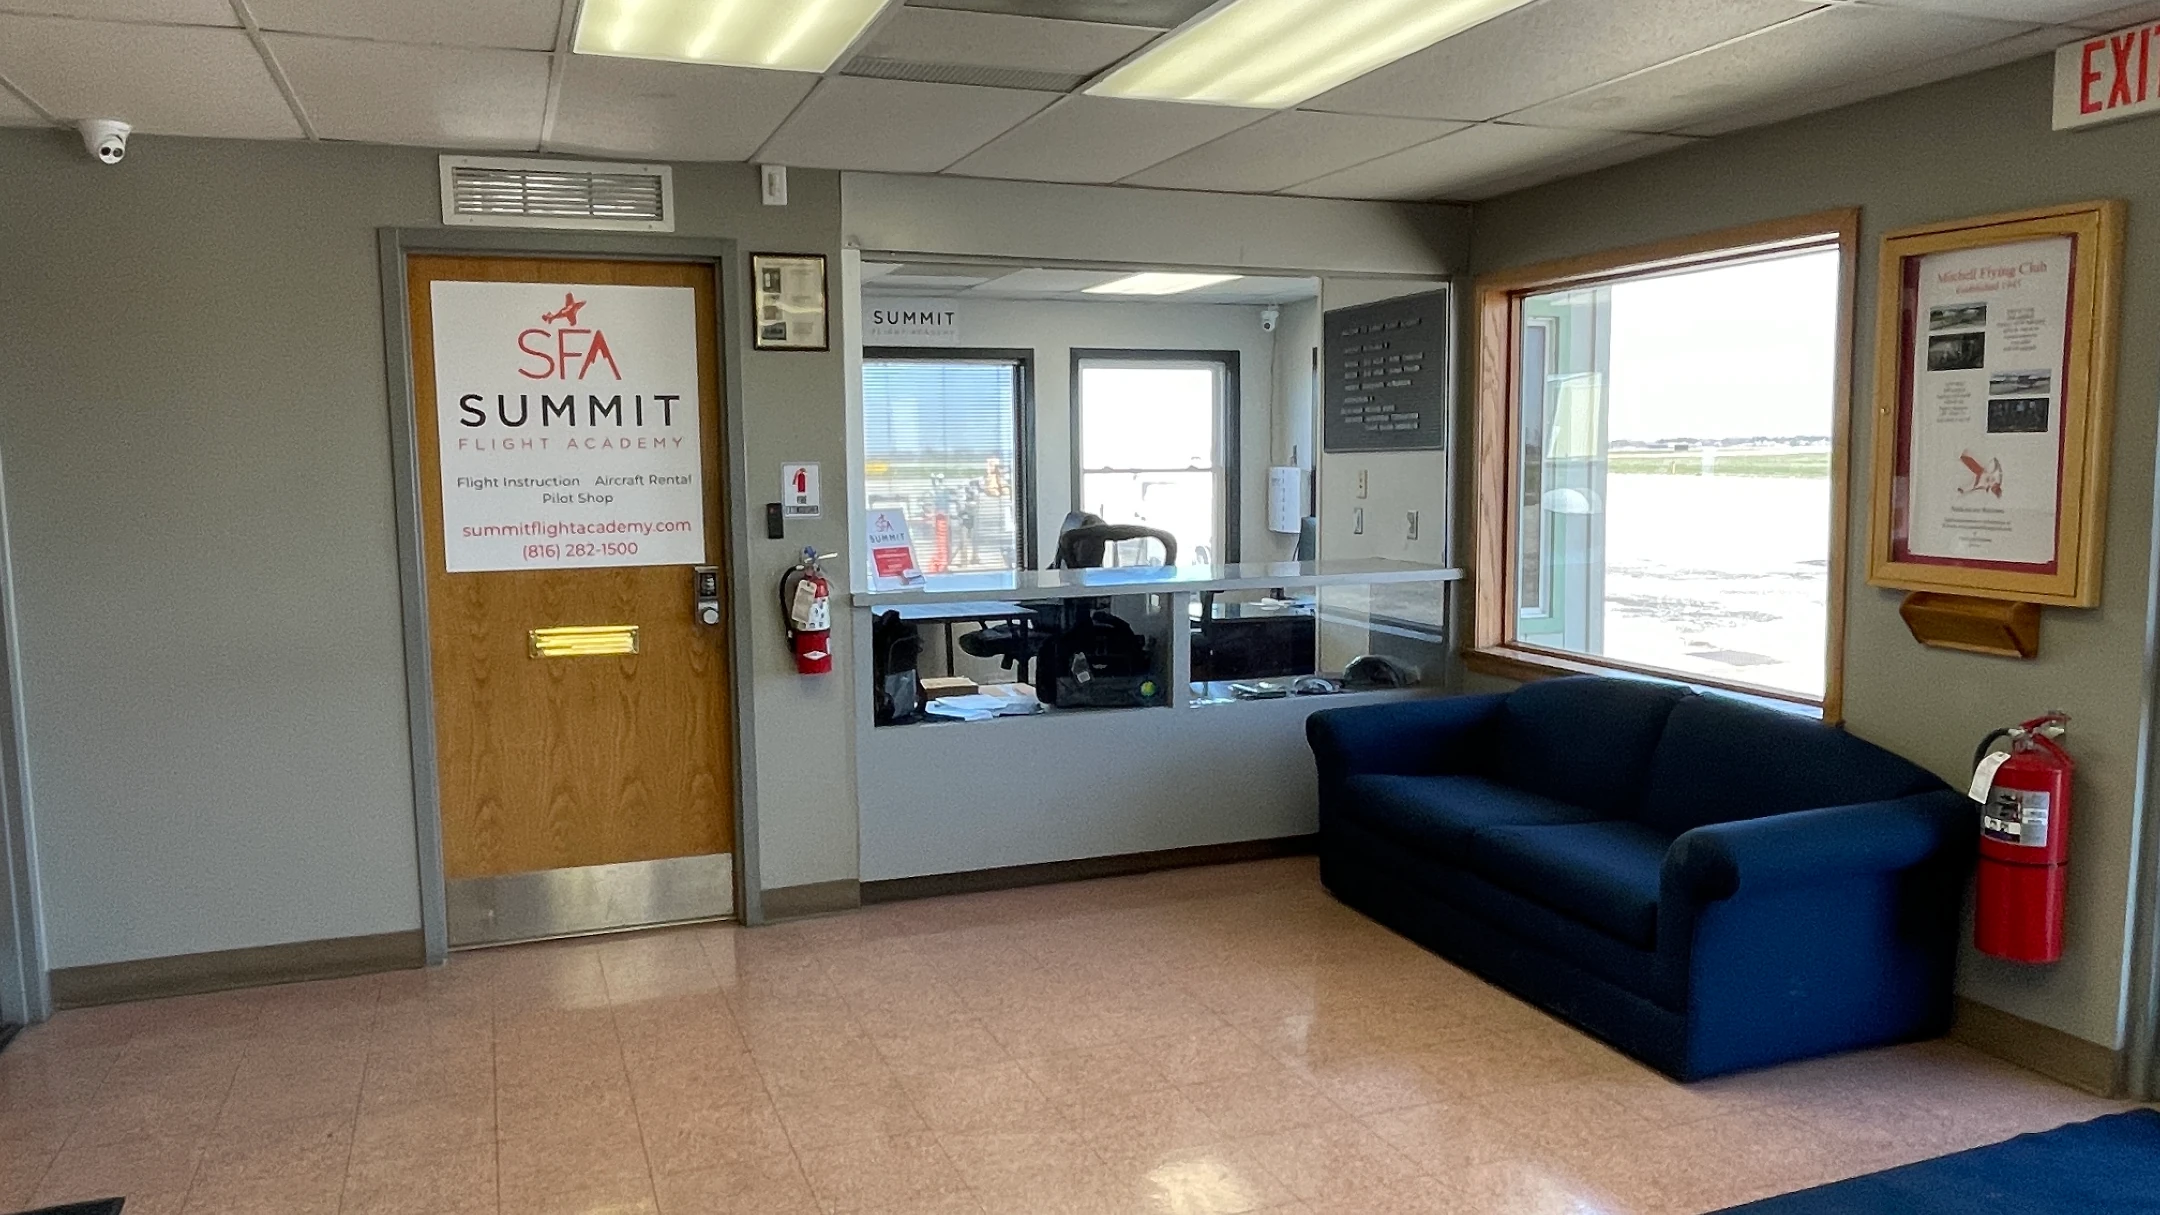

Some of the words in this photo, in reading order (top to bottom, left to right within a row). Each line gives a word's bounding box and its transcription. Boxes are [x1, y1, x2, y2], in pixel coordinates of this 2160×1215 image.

[2080, 24, 2160, 114] EXI
[2018, 260, 2047, 275] Club
[873, 310, 954, 325] SUMMIT
[517, 328, 622, 380] SFA
[459, 394, 680, 427] SUMMIT
[458, 437, 549, 451] FLIGHT
[567, 436, 684, 450] ACADEMY
[457, 477, 499, 490] Flight
[503, 476, 580, 488] Instruction
[595, 475, 644, 486] Aircraft
[649, 474, 692, 485] Rental
[543, 493, 574, 504] Pilot
[578, 493, 614, 504] Shop
[462, 520, 692, 538] summitflightacademy.com
[869, 533, 905, 543] SUMMIT
[523, 544, 561, 560] (816)
[565, 542, 638, 557] 282-1500
